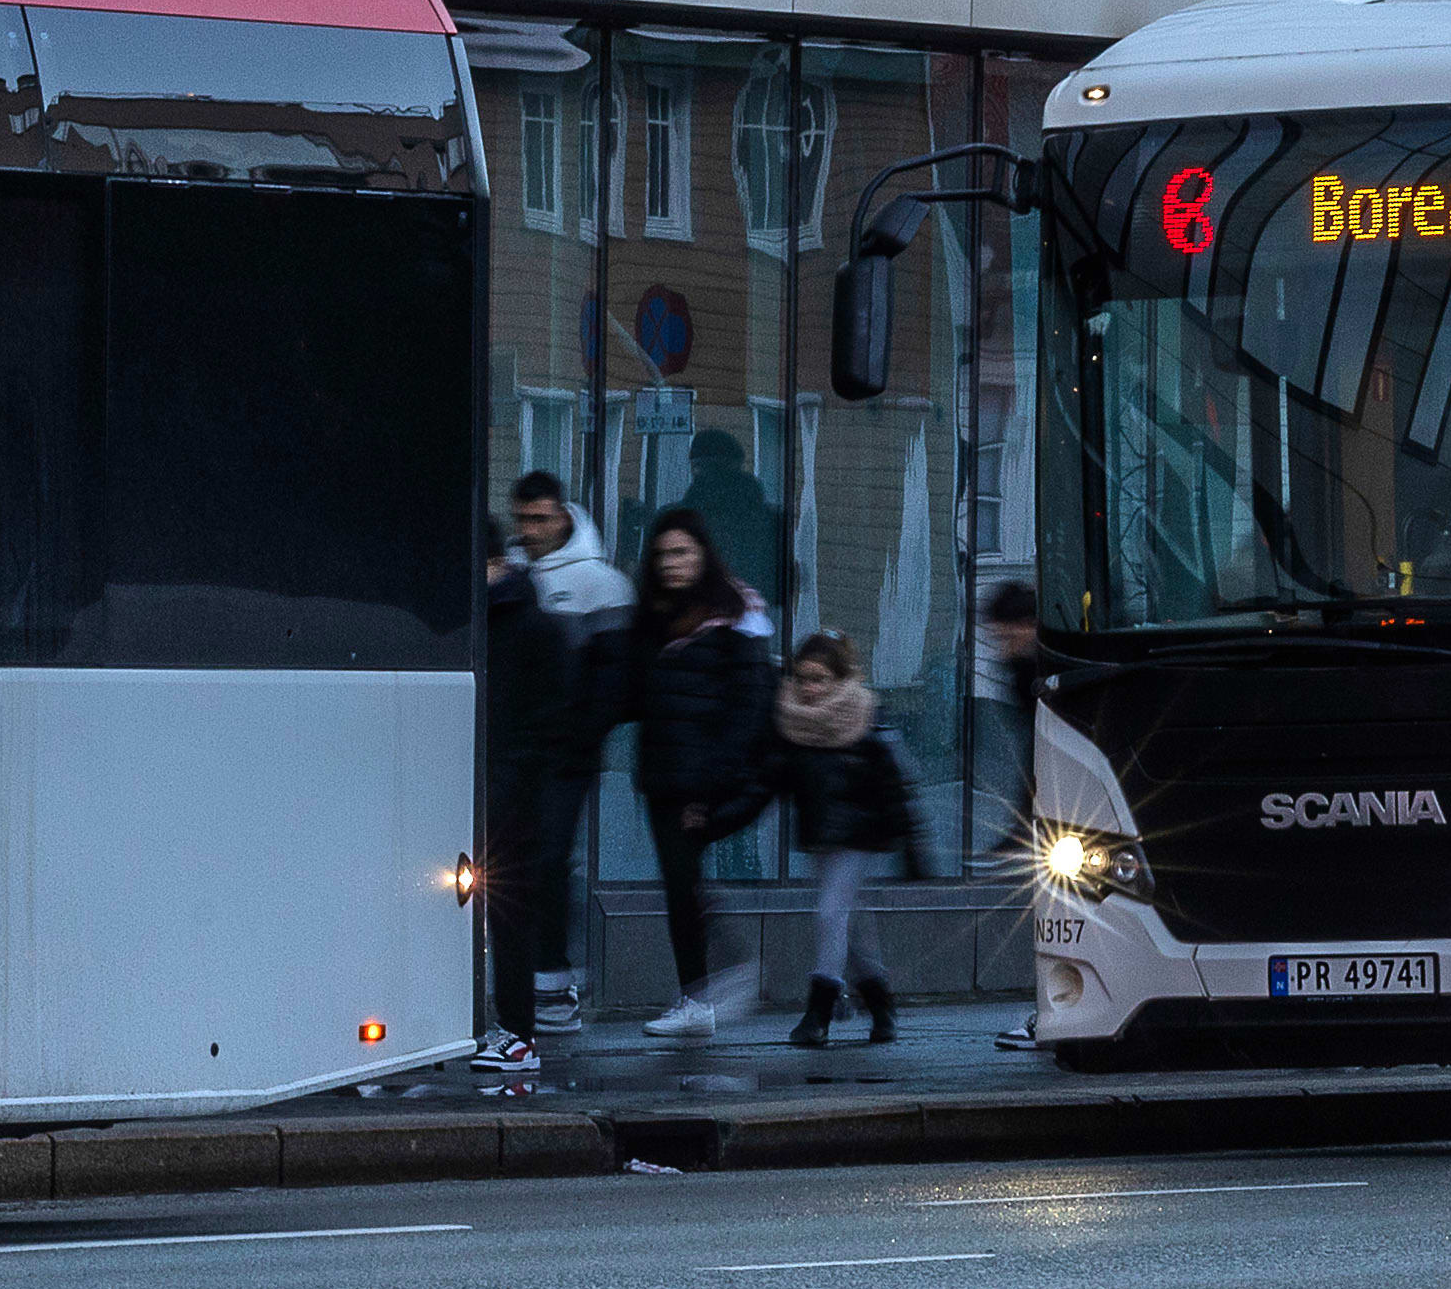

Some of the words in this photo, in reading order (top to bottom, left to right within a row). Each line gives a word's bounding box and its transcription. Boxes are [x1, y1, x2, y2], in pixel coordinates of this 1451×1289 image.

[1260, 789, 1447, 830] SCANIA
[1035, 917, 1085, 944] N3157
[1297, 961, 1330, 991] PR
[1344, 960, 1427, 989] 49741
